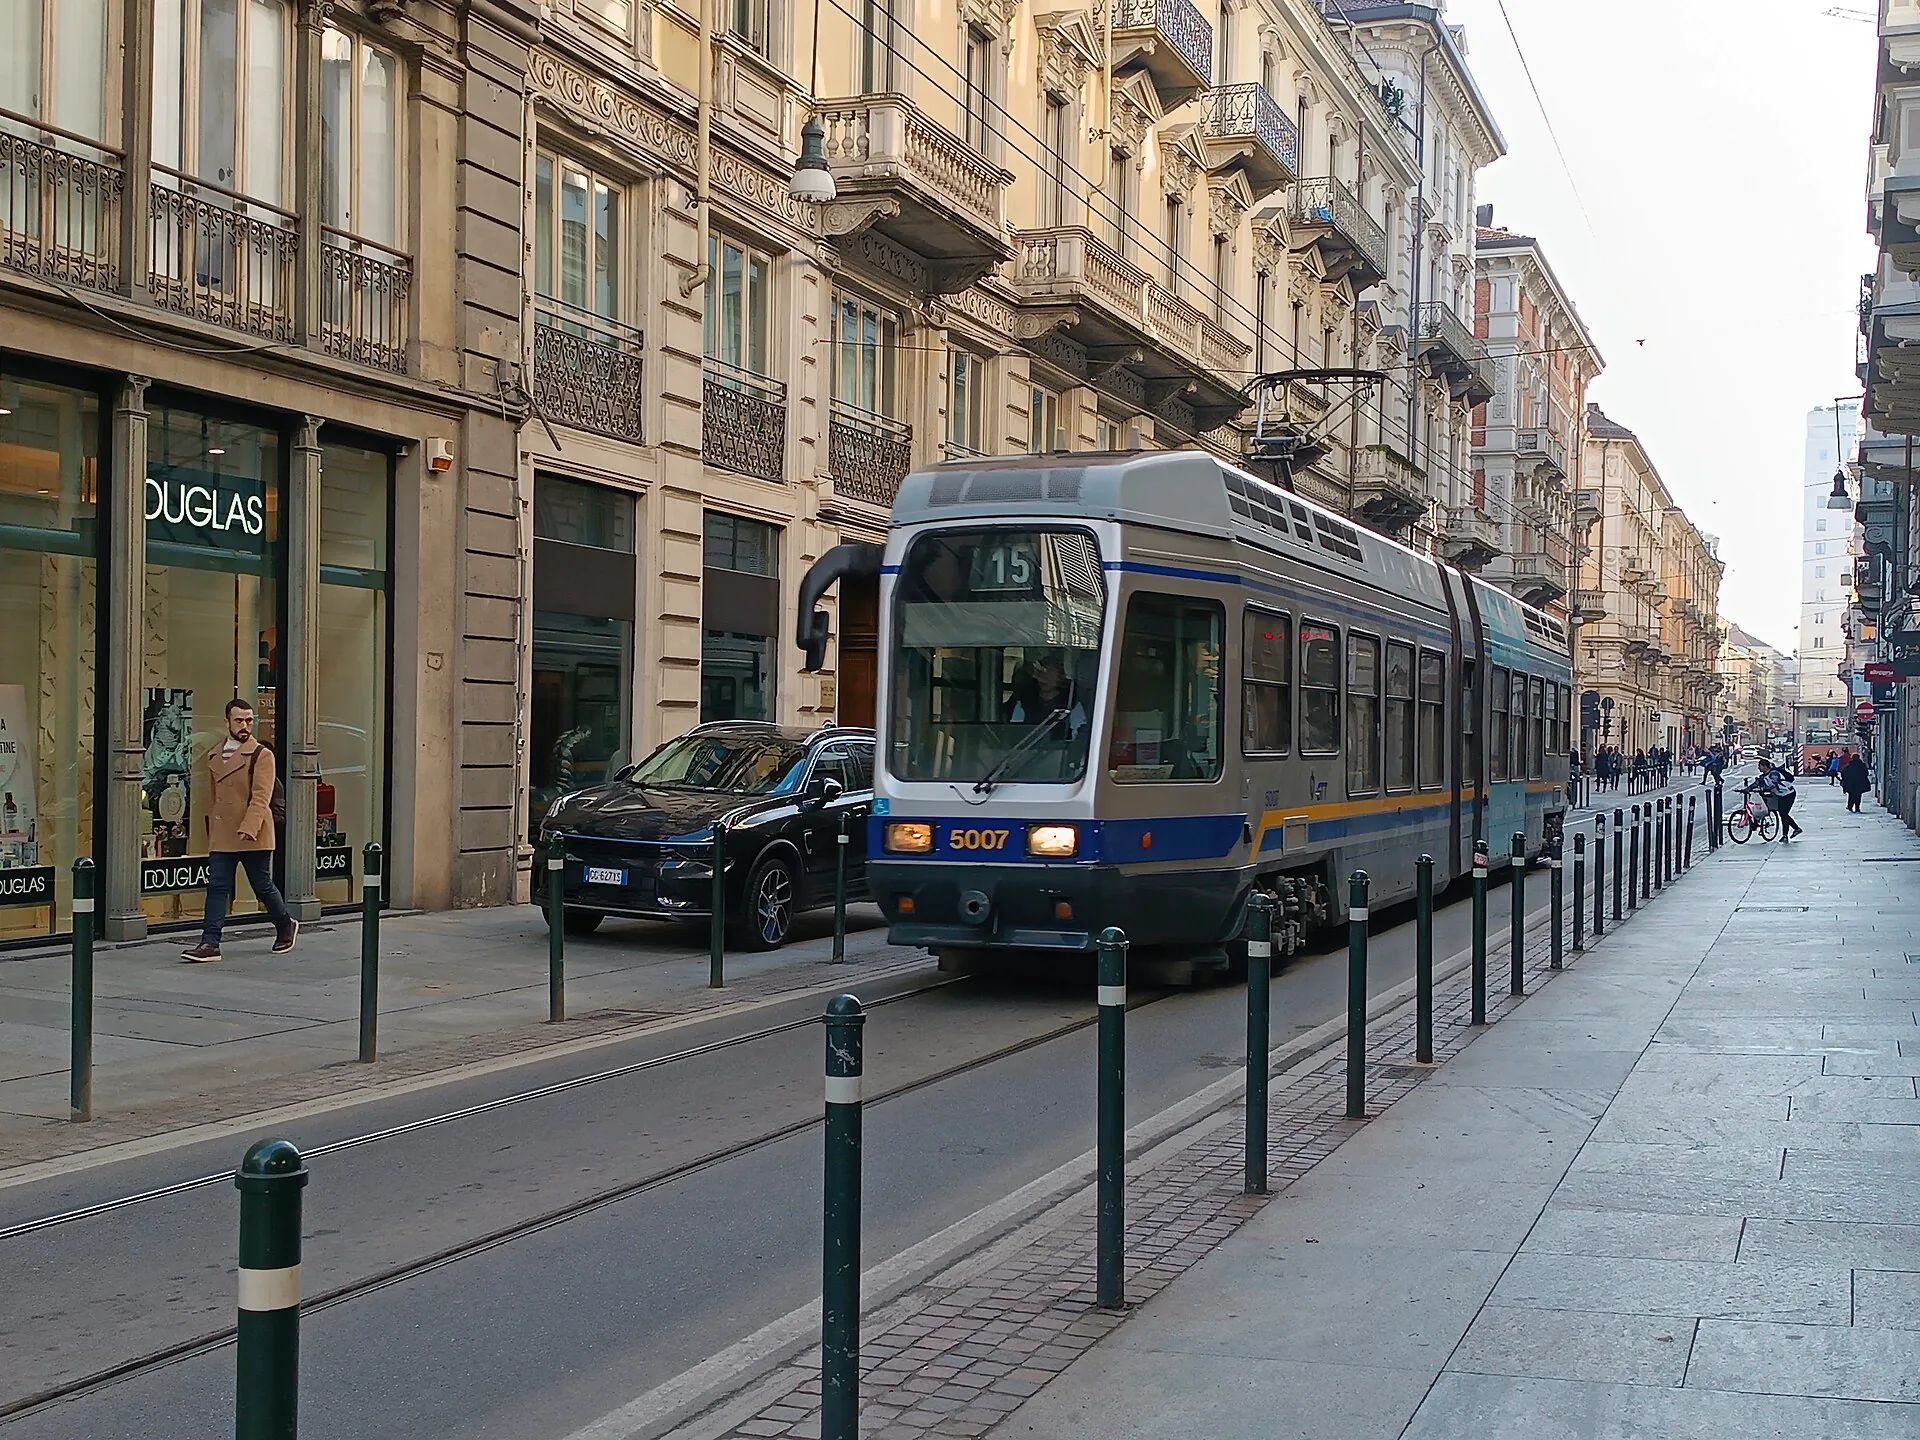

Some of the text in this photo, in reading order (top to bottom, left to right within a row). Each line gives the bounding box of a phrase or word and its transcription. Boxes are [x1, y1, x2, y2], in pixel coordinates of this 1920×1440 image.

[145, 478, 263, 535] OUGLAS
[992, 545, 1030, 584] 15
[949, 829, 1009, 850] 5007
[316, 854, 346, 870] UGLAS
[0, 876, 45, 895] UGLAS
